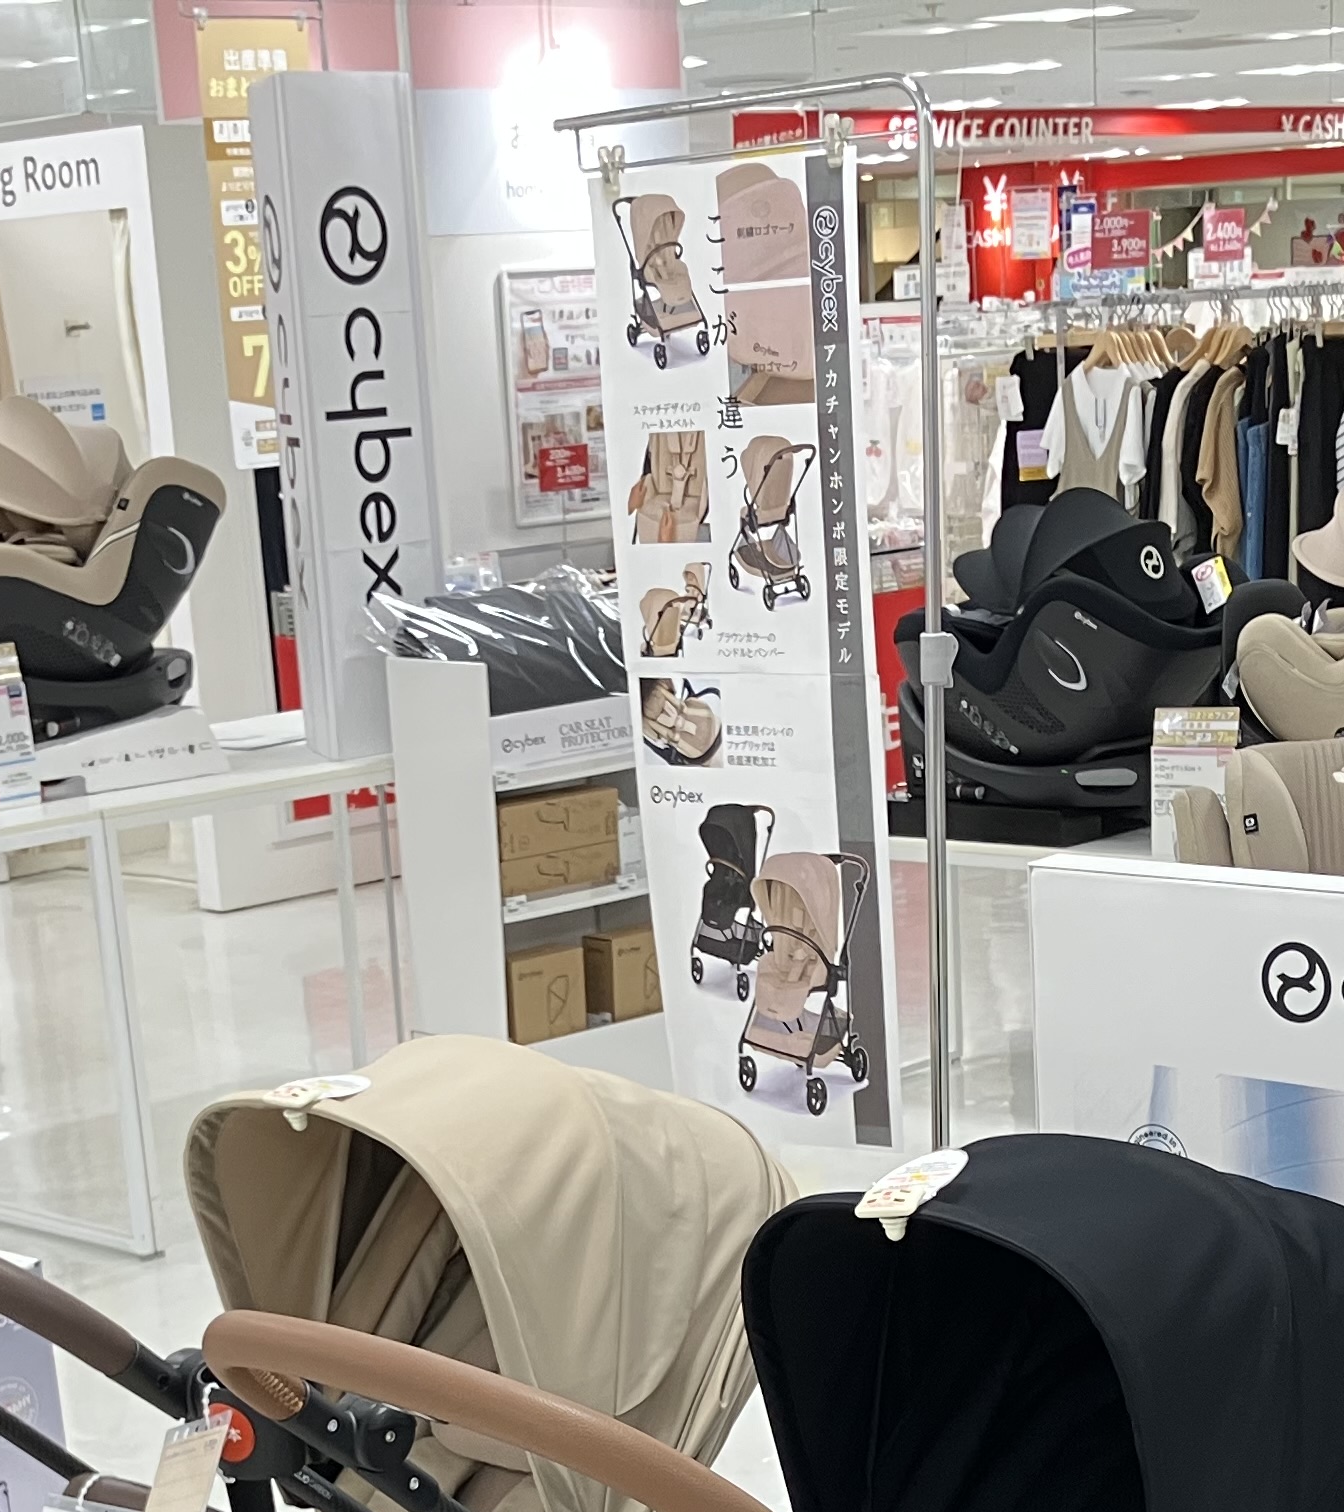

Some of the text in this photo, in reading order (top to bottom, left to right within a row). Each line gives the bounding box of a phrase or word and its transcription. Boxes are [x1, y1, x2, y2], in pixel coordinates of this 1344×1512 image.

[888, 116, 1094, 150] SEVICE COUNTER
[23, 156, 100, 192] Room
[325, 306, 413, 599] cybex
[812, 239, 852, 665] cybex アカチャンホンポ限定モデル
[664, 785, 704, 808] cybex
